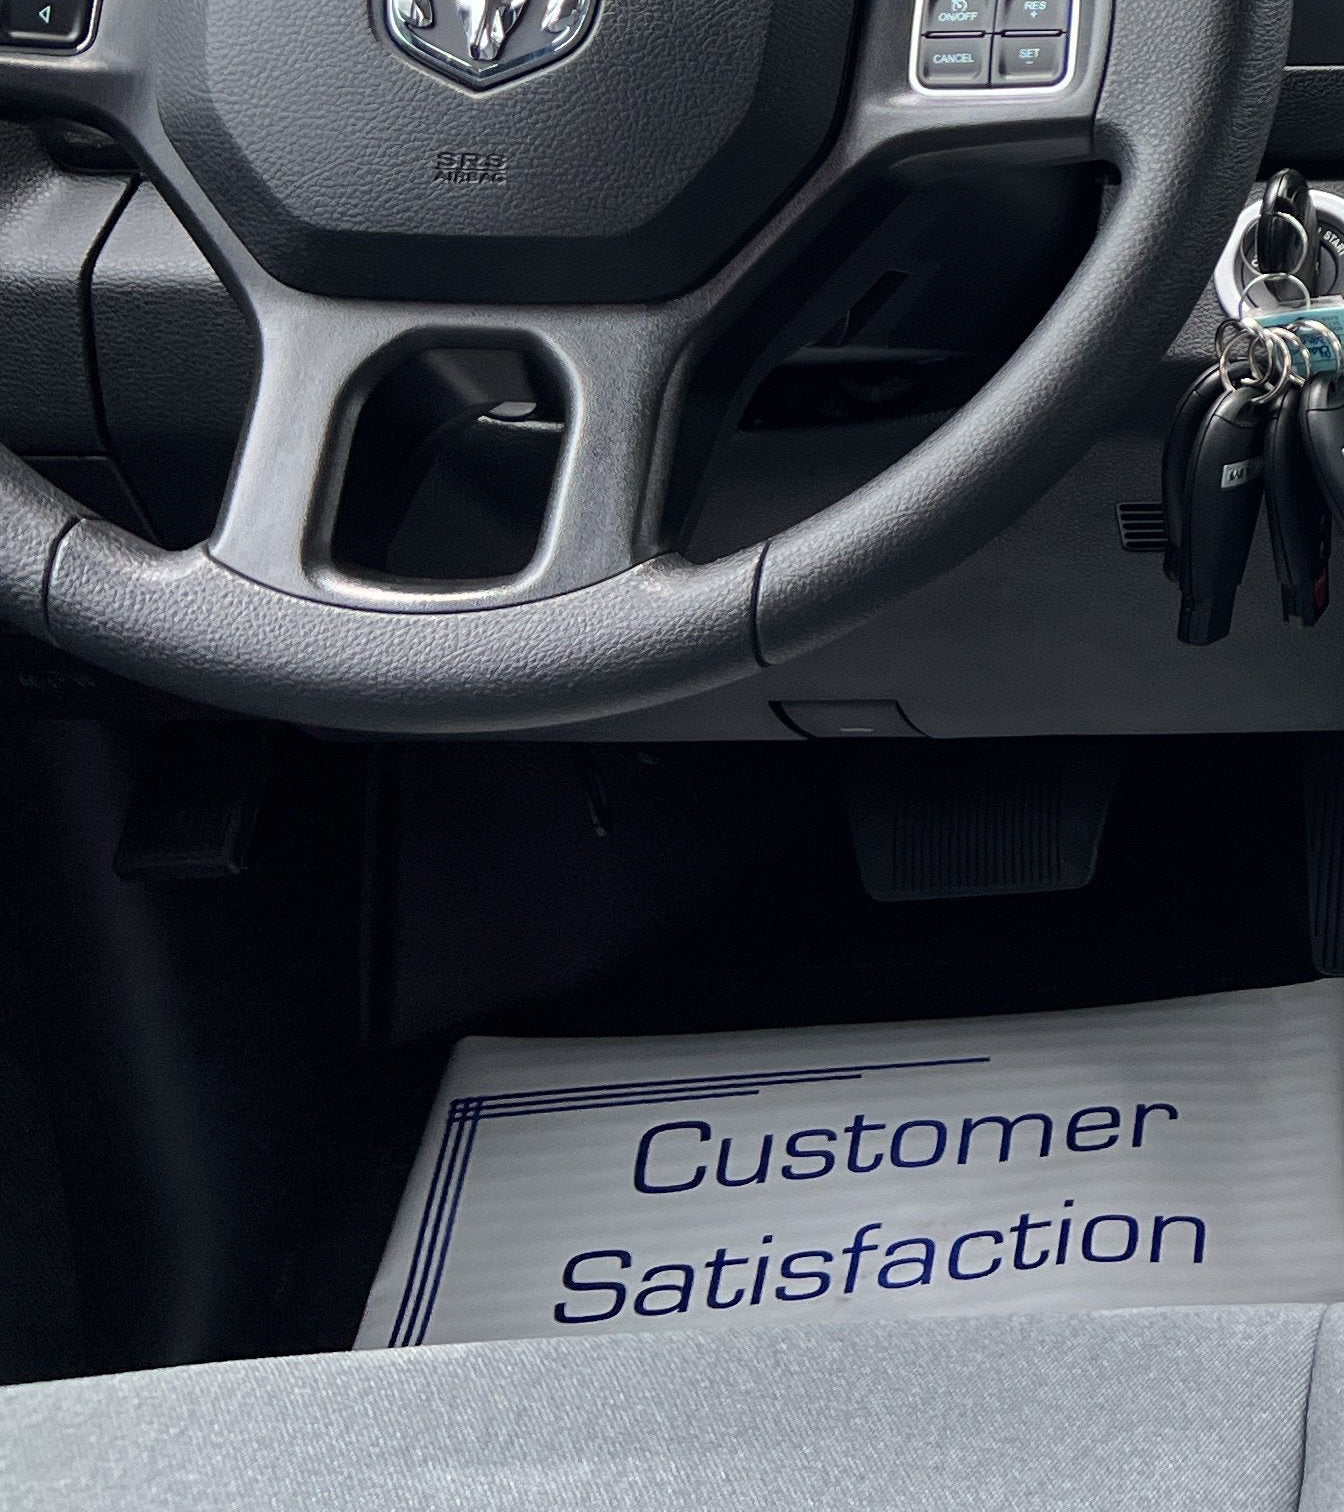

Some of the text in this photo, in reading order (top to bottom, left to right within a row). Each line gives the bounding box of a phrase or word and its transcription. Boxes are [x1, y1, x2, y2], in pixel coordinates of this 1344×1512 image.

[1024, 0, 1047, 10] RES
[938, 11, 979, 22] ON/OFF
[932, 53, 975, 64] CANCEL
[1018, 48, 1040, 58] SET
[434, 152, 506, 169] SRS
[632, 1101, 1179, 1195] Customer
[553, 1199, 1207, 1324] Satisfaction
